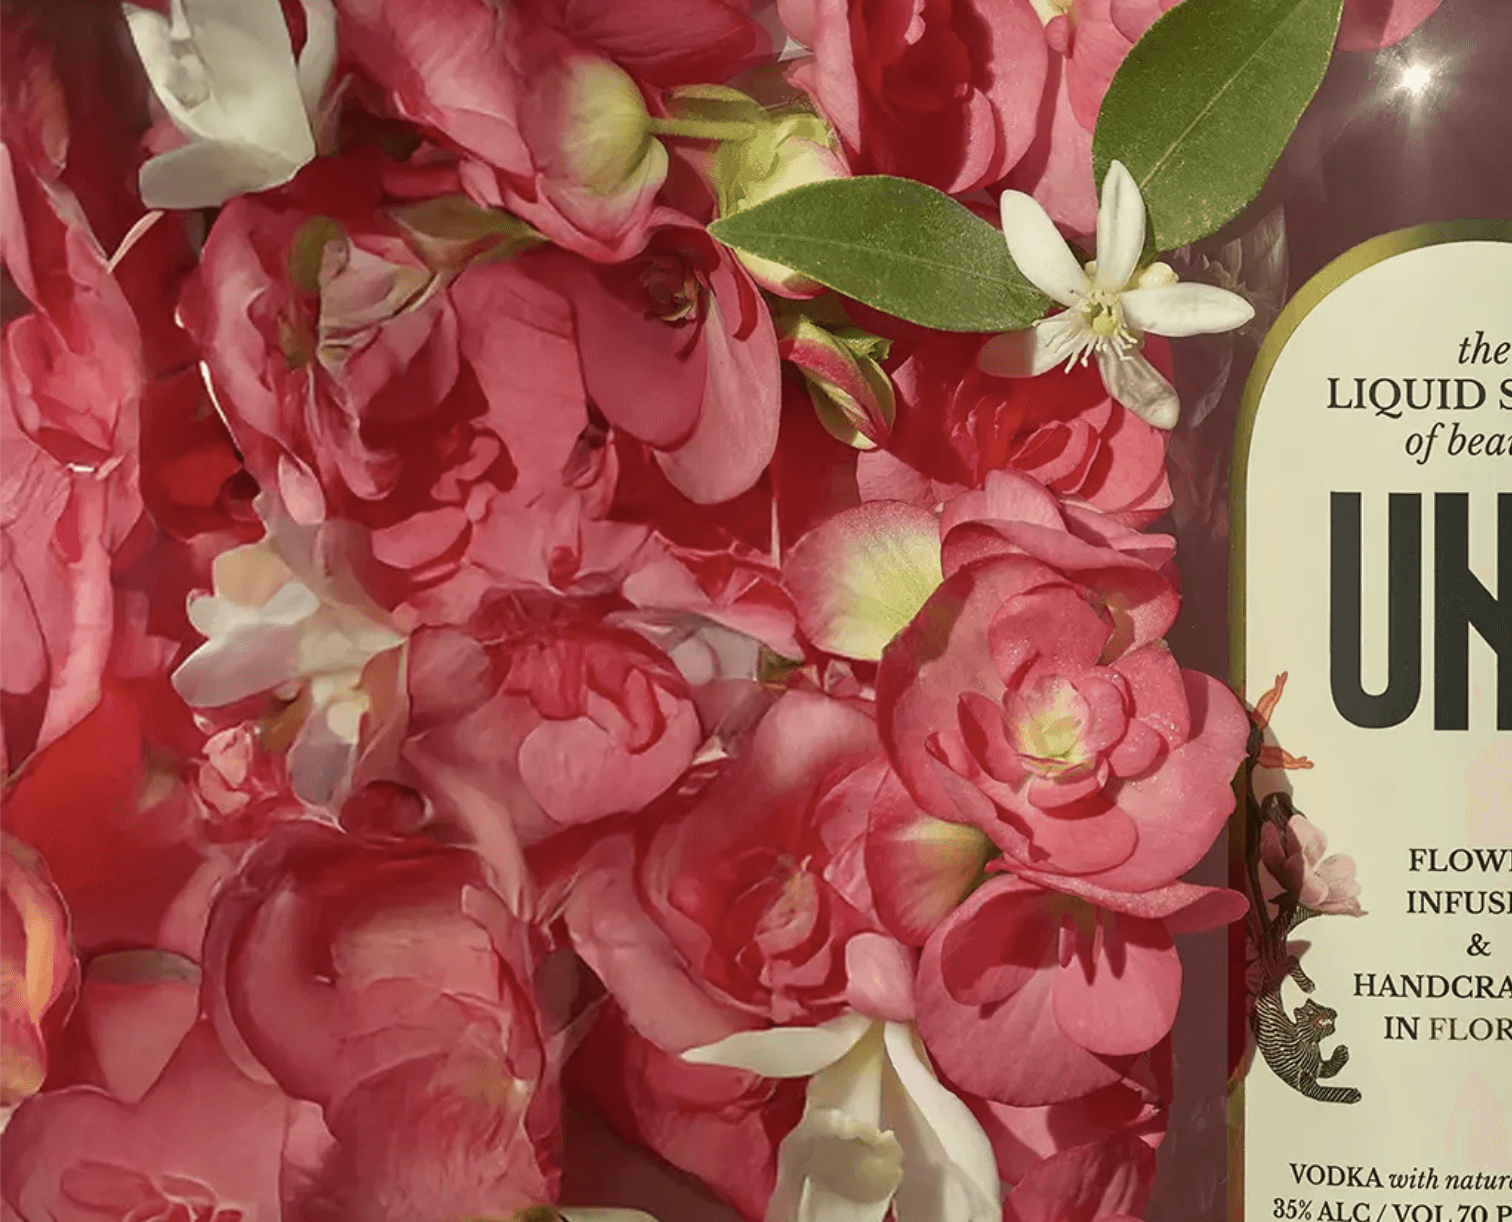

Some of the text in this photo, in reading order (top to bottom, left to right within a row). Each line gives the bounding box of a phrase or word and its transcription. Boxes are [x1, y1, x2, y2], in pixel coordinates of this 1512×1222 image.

[1458, 330, 1511, 365] the
[1327, 377, 1487, 419] LIQUID
[1405, 422, 1447, 465] of
[1466, 932, 1492, 957] &
[1383, 1015, 1421, 1041] IN
[1289, 1162, 1384, 1189] VODKA
[1388, 1167, 1439, 1190] with
[1273, 1197, 1312, 1221] 35%
[1316, 1200, 1371, 1222] ALC
[1457, 1204, 1488, 1222] 70
